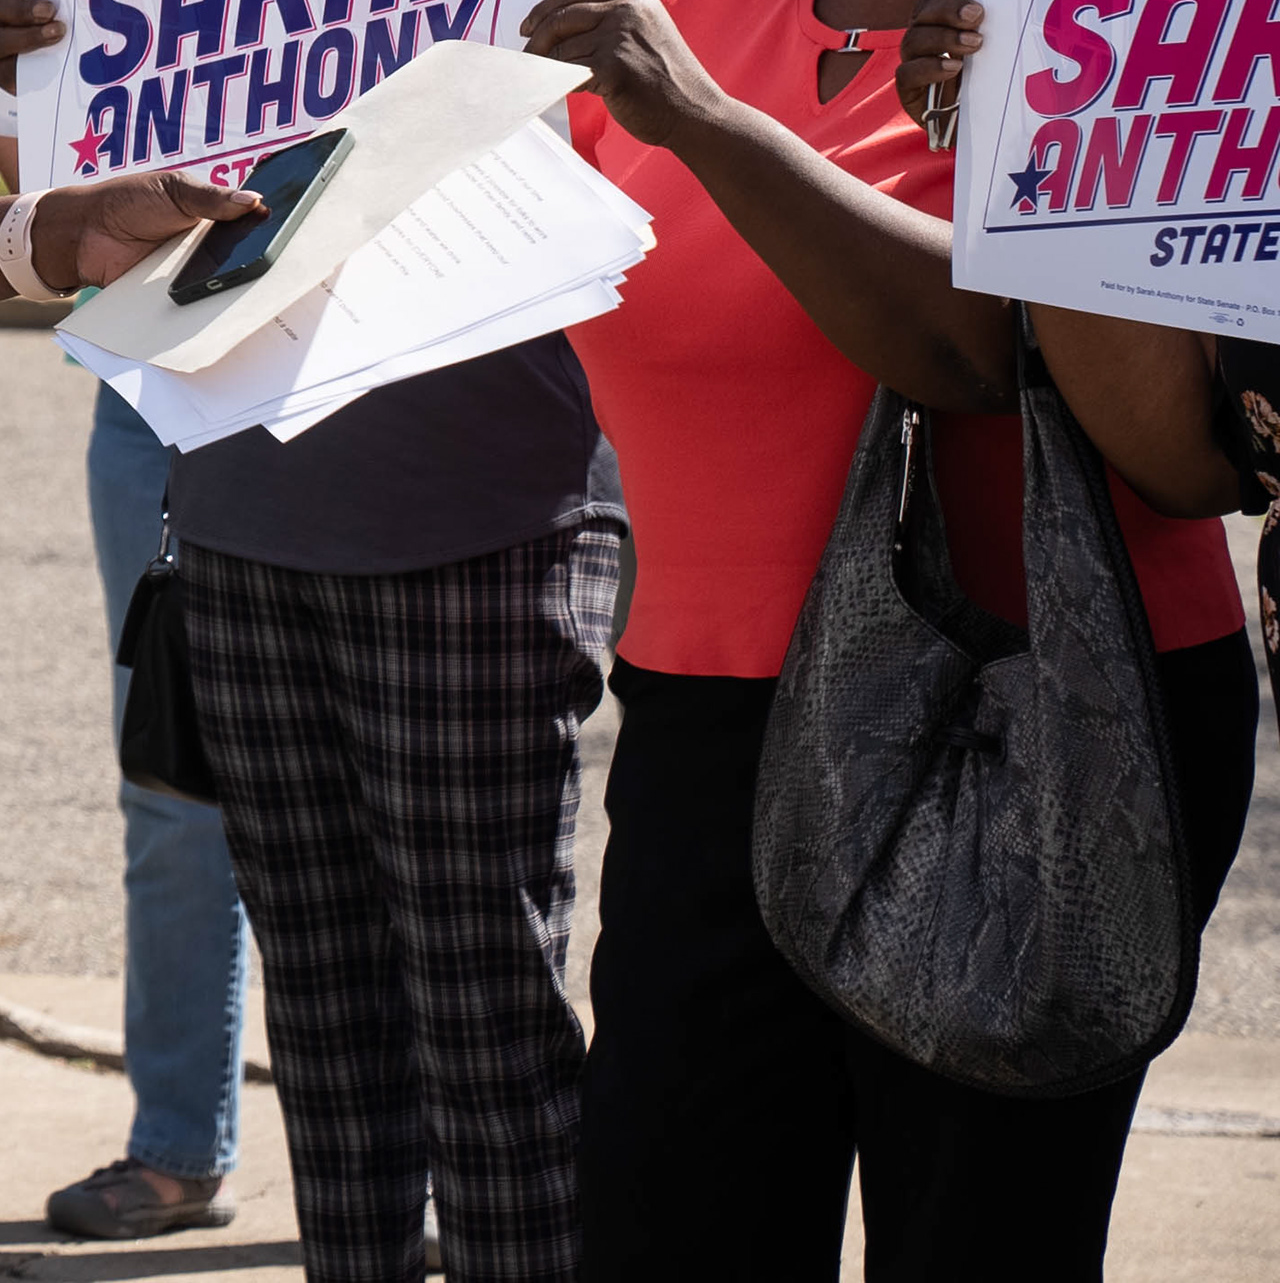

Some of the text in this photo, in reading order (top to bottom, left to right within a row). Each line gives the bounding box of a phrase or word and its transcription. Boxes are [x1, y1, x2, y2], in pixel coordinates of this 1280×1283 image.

[1017, 105, 1280, 216] ANTH
[1149, 222, 1280, 268] STATE
[1127, 285, 1135, 294] by
[1136, 286, 1156, 297] Sarah
[1156, 290, 1185, 302] Anthony
[1197, 296, 1215, 306] State
